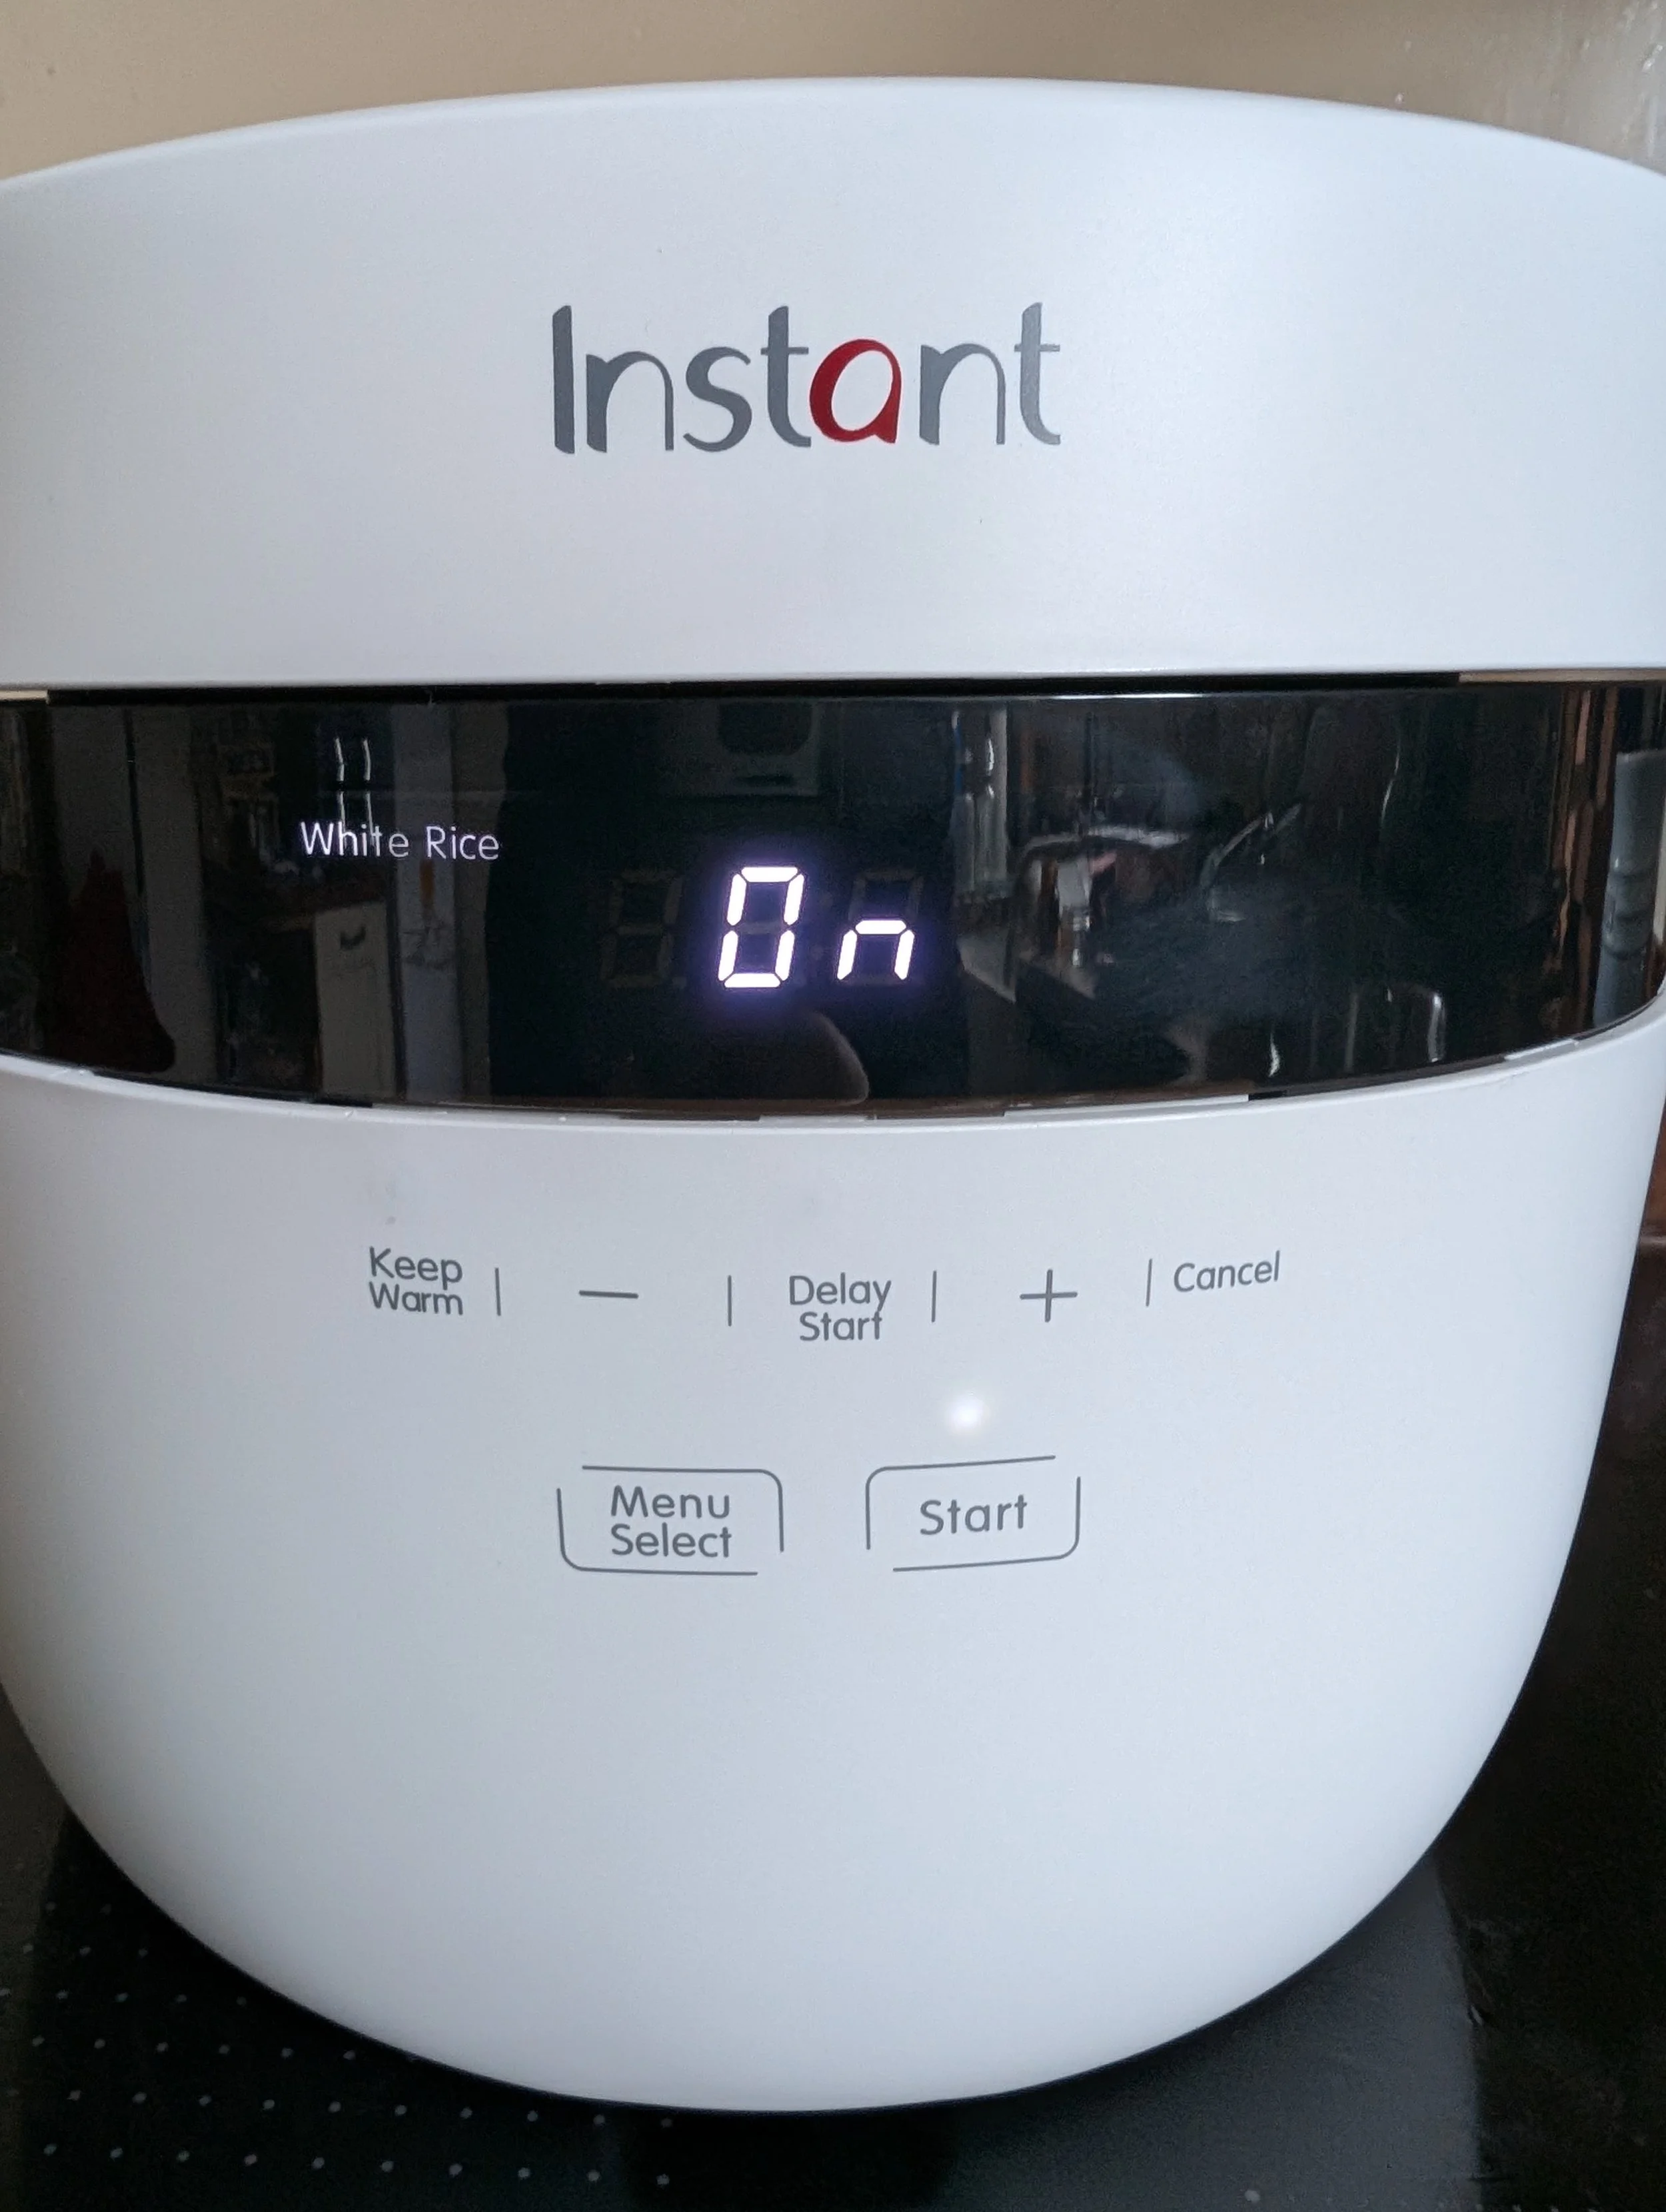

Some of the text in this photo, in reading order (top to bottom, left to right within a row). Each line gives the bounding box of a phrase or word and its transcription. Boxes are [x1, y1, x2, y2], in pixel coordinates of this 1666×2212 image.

[552, 302, 1061, 454] Instant
[299, 822, 500, 859] White Rice
[369, 1247, 462, 1290] Keep
[1173, 1251, 1281, 1293] Cancel
[369, 1282, 463, 1315] Warm
[789, 1273, 892, 1311] Delay
[799, 1311, 883, 1341] Start
[610, 1486, 730, 1519] Menu
[920, 1494, 1028, 1535] Start
[610, 1522, 732, 1558] Select
